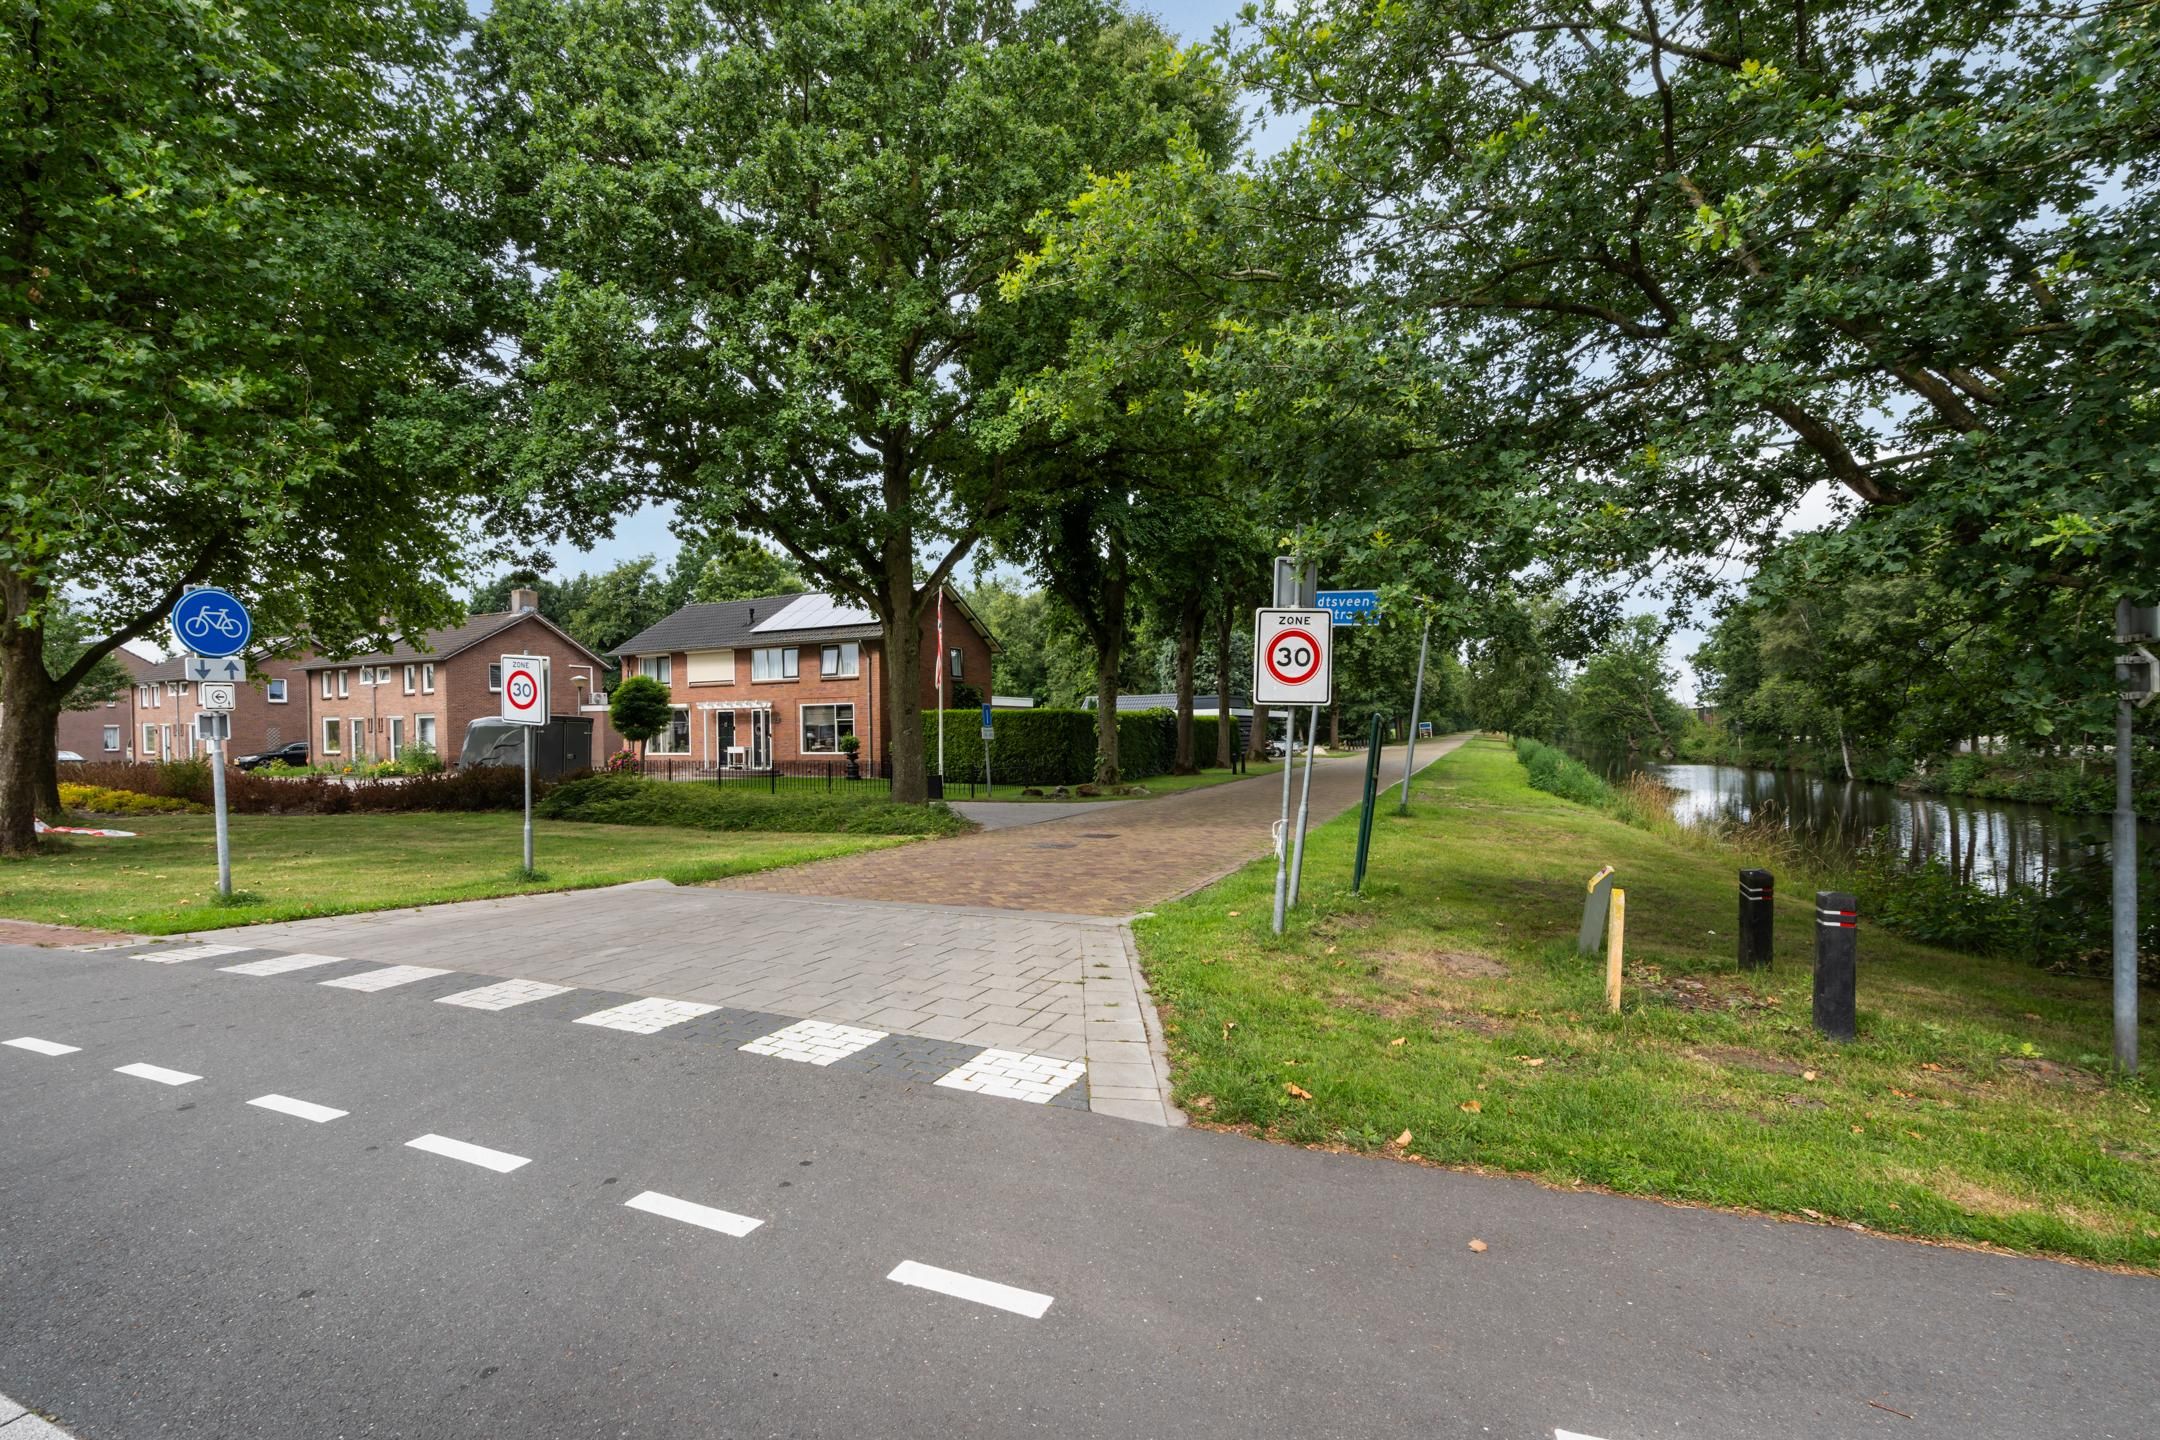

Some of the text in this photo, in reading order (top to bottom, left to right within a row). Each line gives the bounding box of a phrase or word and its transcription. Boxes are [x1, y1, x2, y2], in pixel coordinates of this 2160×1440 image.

[1317, 596, 1377, 608] dtsveen-
[1279, 616, 1311, 625] ZONE
[1276, 647, 1311, 667] 30
[512, 682, 532, 698] 30
